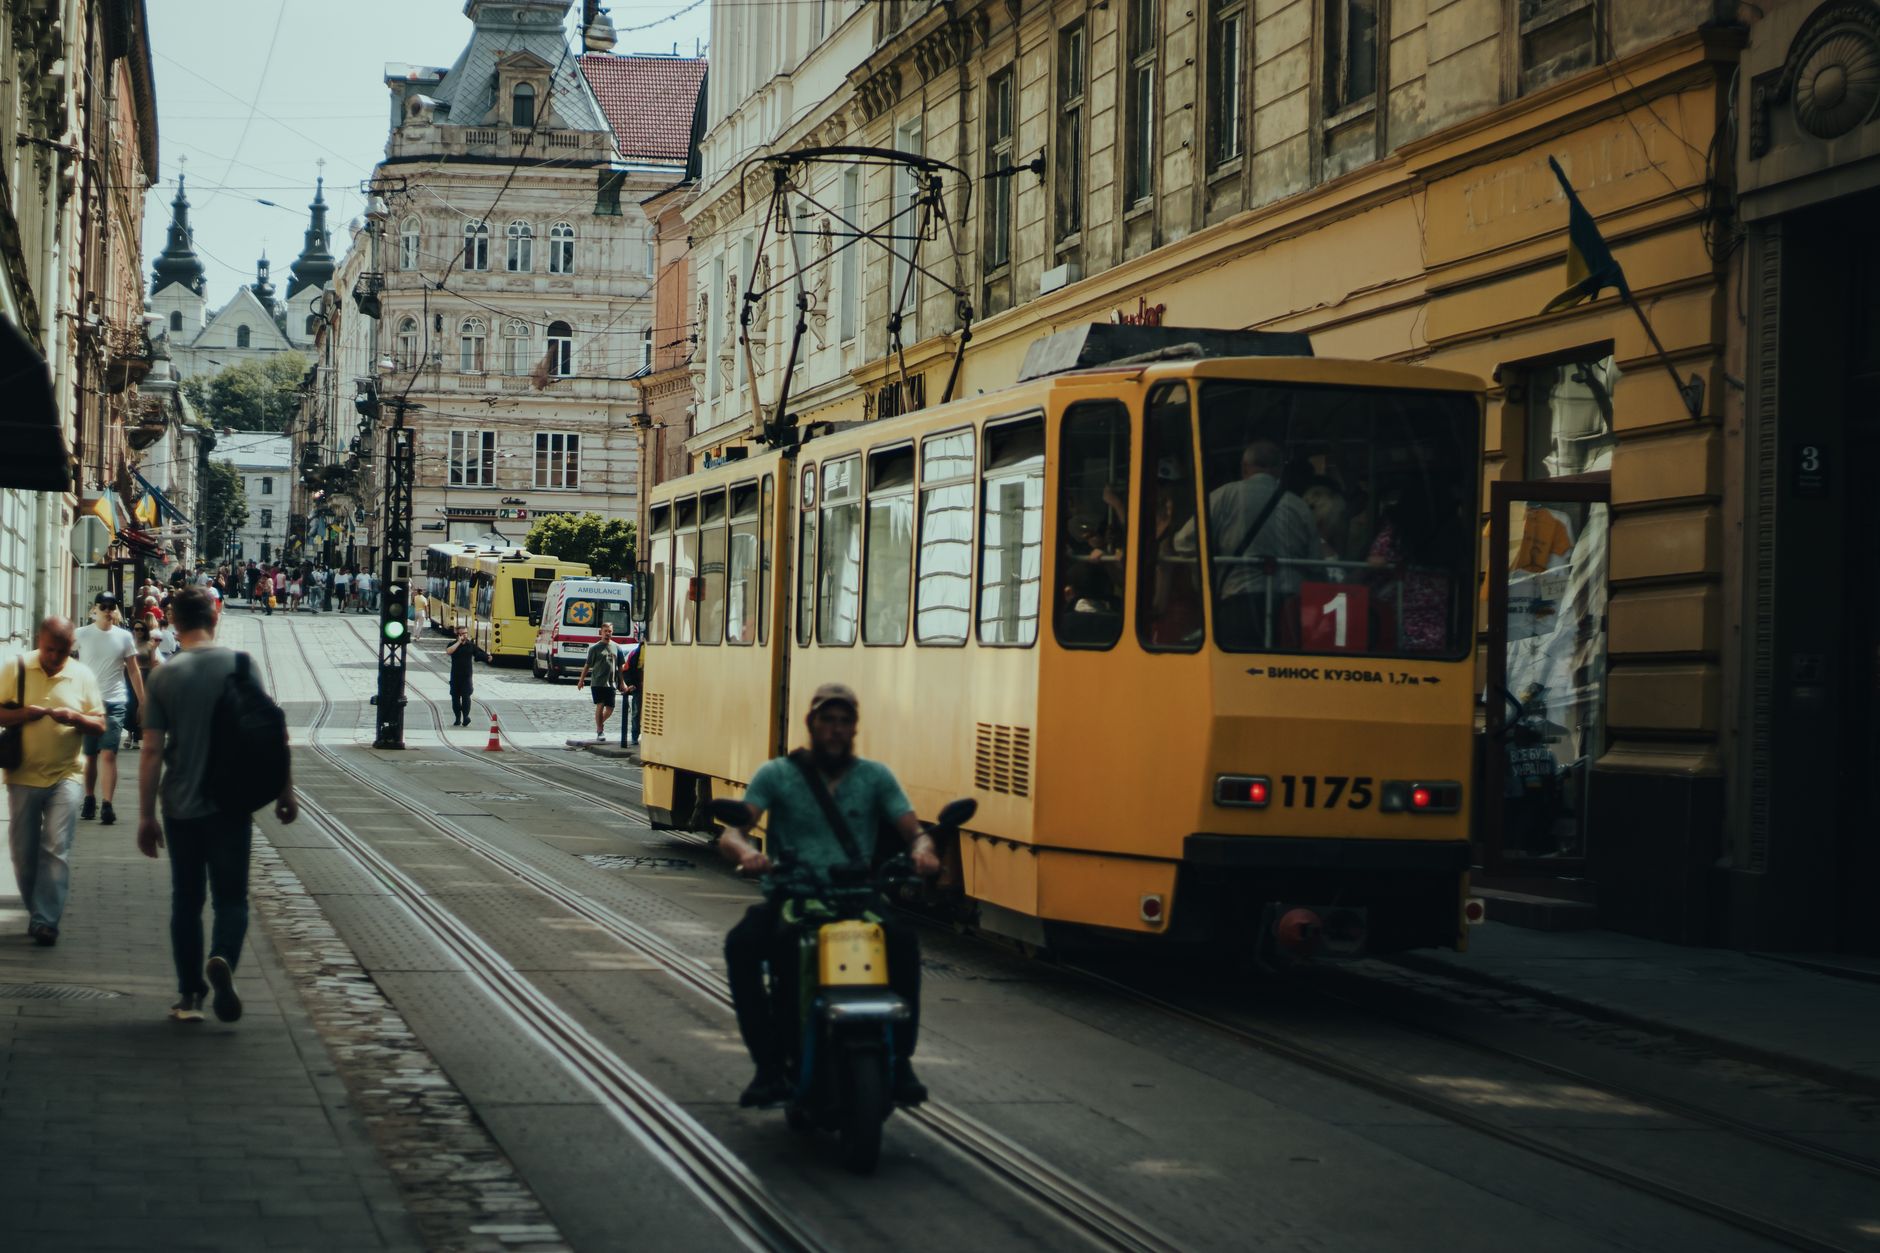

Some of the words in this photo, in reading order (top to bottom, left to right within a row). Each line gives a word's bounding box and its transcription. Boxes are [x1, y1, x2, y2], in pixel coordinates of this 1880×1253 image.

[1802, 446, 1820, 471] 3
[578, 587, 621, 595] AMBULANCE
[1323, 592, 1347, 647] 1
[1268, 666, 1319, 680] ВИНОС
[1324, 669, 1383, 683] КУЗОВА
[1389, 672, 1419, 685] 1,7м
[1281, 775, 1373, 810] 1175
